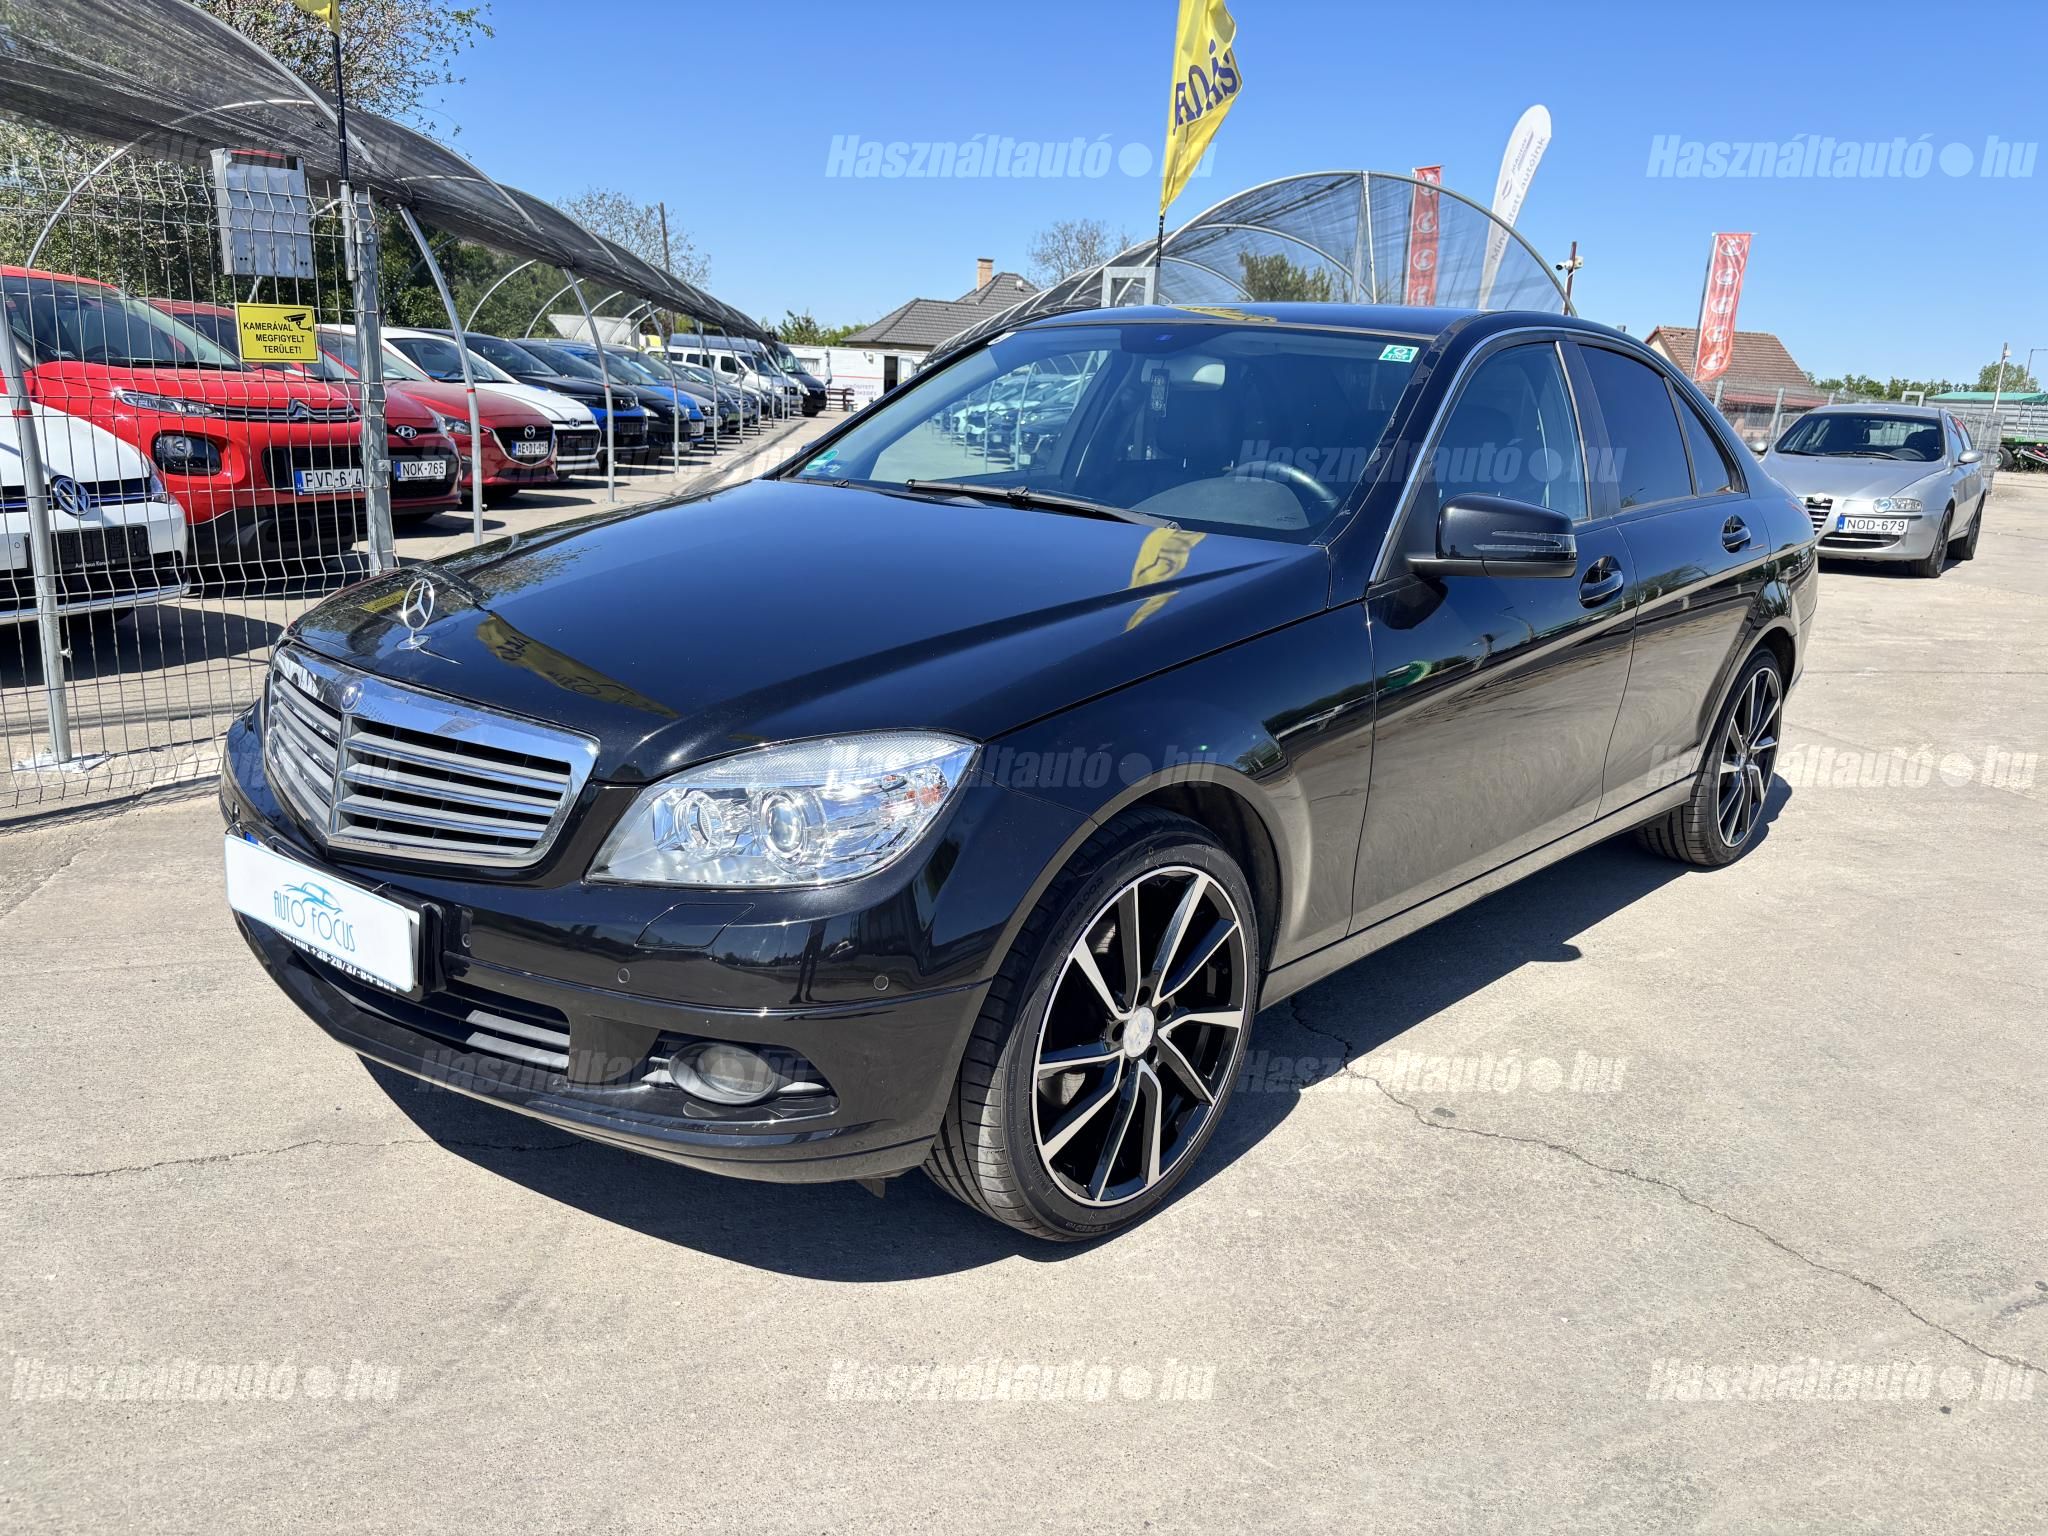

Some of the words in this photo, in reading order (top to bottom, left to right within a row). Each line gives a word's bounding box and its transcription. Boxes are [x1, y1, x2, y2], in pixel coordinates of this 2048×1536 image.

[243, 321, 293, 332] KAMERÁVAL
[256, 334, 305, 343] MEGFIGYELT
[403, 462, 445, 476] NOK-765
[304, 470, 362, 488] PVD-64
[1847, 519, 1905, 531] NOD-679
[273, 890, 305, 928] AUTO
[311, 906, 356, 953] FOCUS
